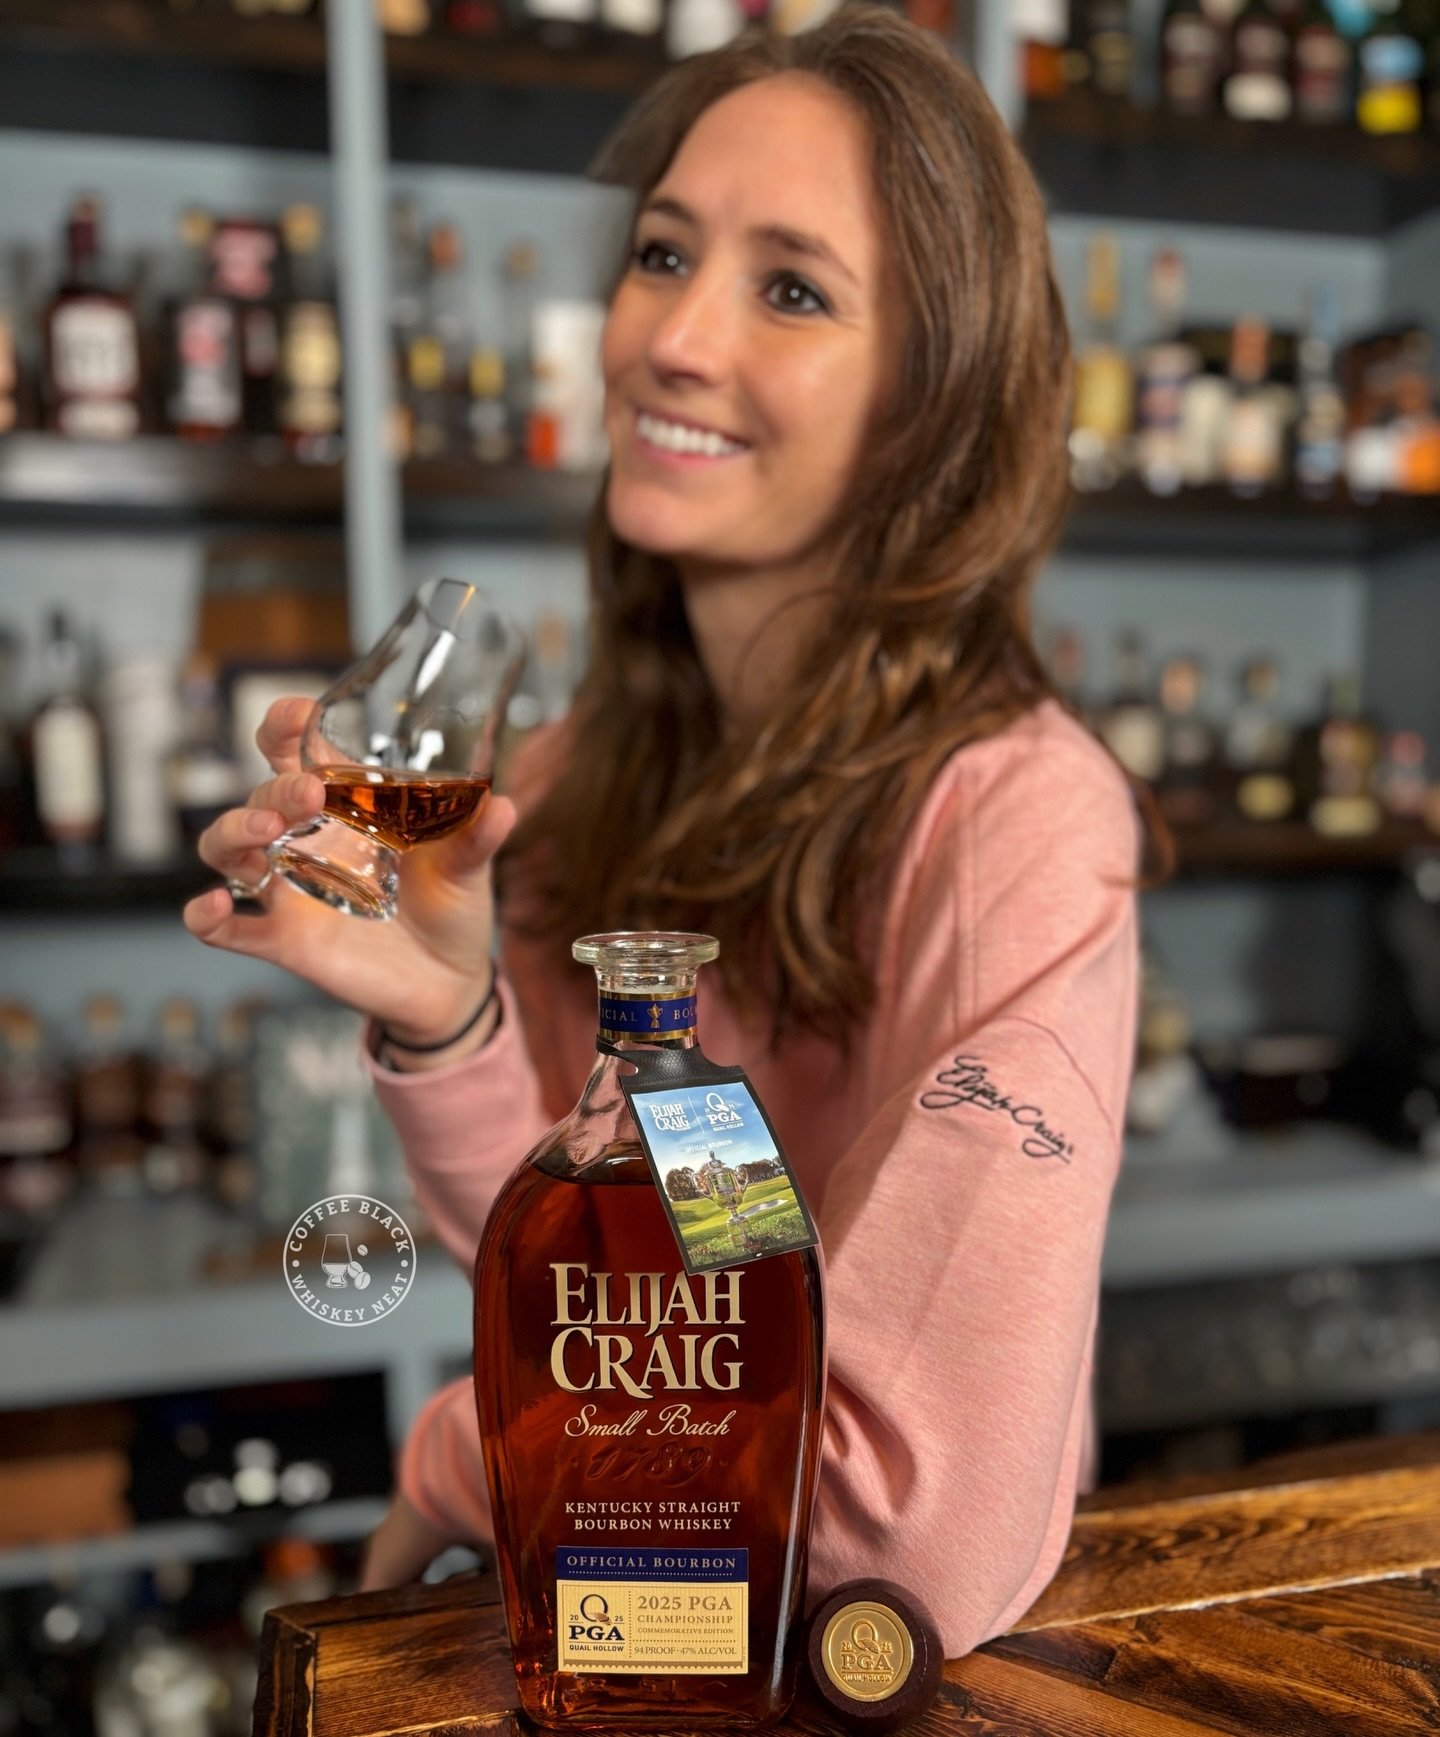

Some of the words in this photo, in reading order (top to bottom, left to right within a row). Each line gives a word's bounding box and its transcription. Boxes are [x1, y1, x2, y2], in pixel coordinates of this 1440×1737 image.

[649, 1103, 685, 1120] ELIJAH
[706, 1110, 742, 1125] PGA
[655, 1115, 692, 1131] CRAIG
[549, 1263, 746, 1337] ELIJAH
[551, 1326, 744, 1399] CRAIG
[564, 1403, 649, 1437] Small
[646, 1403, 737, 1436] Batch
[565, 1502, 653, 1514] KENTUCKY
[658, 1501, 741, 1514] STRAIGHT
[574, 1519, 652, 1531] BOURBON
[659, 1518, 733, 1530] WHISKEY
[567, 1555, 647, 1568] OFFICIAL
[653, 1557, 736, 1569] BOURBON
[638, 1595, 682, 1610] 2025
[688, 1596, 733, 1611] PGA
[637, 1615, 733, 1624] CHAMPIONSHIP
[568, 1625, 625, 1641] PGA
[645, 1646, 676, 1655] PROOF
[680, 1647, 697, 1655] 47%
[698, 1647, 737, 1655] ALC/VOL
[841, 1653, 893, 1671] PGA
